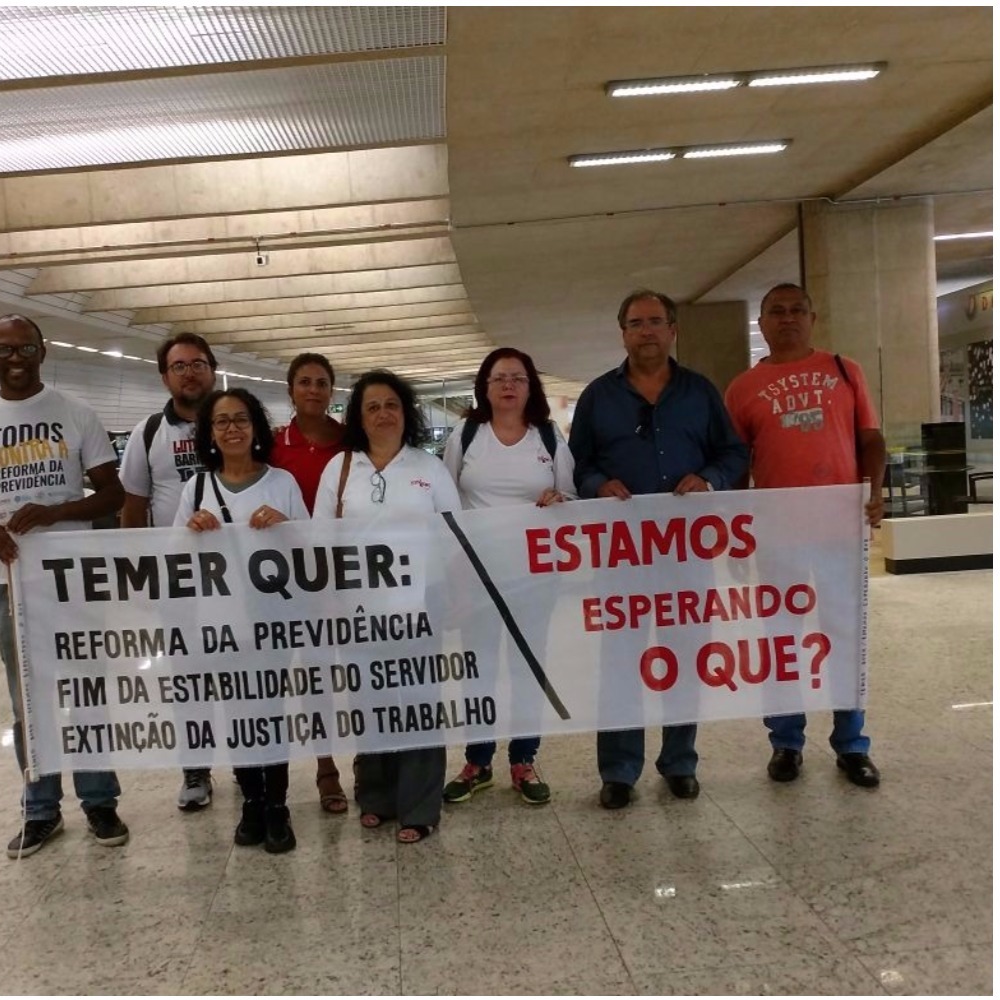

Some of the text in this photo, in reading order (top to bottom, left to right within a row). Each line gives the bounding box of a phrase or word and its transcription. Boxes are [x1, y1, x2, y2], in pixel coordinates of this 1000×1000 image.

[758, 372, 838, 400] TSYSTEM
[49, 460, 65, 472] DA
[175, 454, 200, 467] BAR
[526, 514, 756, 574] ESTAMOS
[42, 544, 411, 603] TEMER QUER:
[55, 606, 433, 661] REFORMA DA PREVIDÊNCIA
[583, 583, 817, 632] ESPERANDO
[57, 650, 479, 709] FIM DA ESTABILIDADE DO SERVIDOR
[640, 632, 831, 692] O QUE?
[62, 696, 497, 755] EXTINÇÃO DA JUSTIÇA DO TRABALHO
